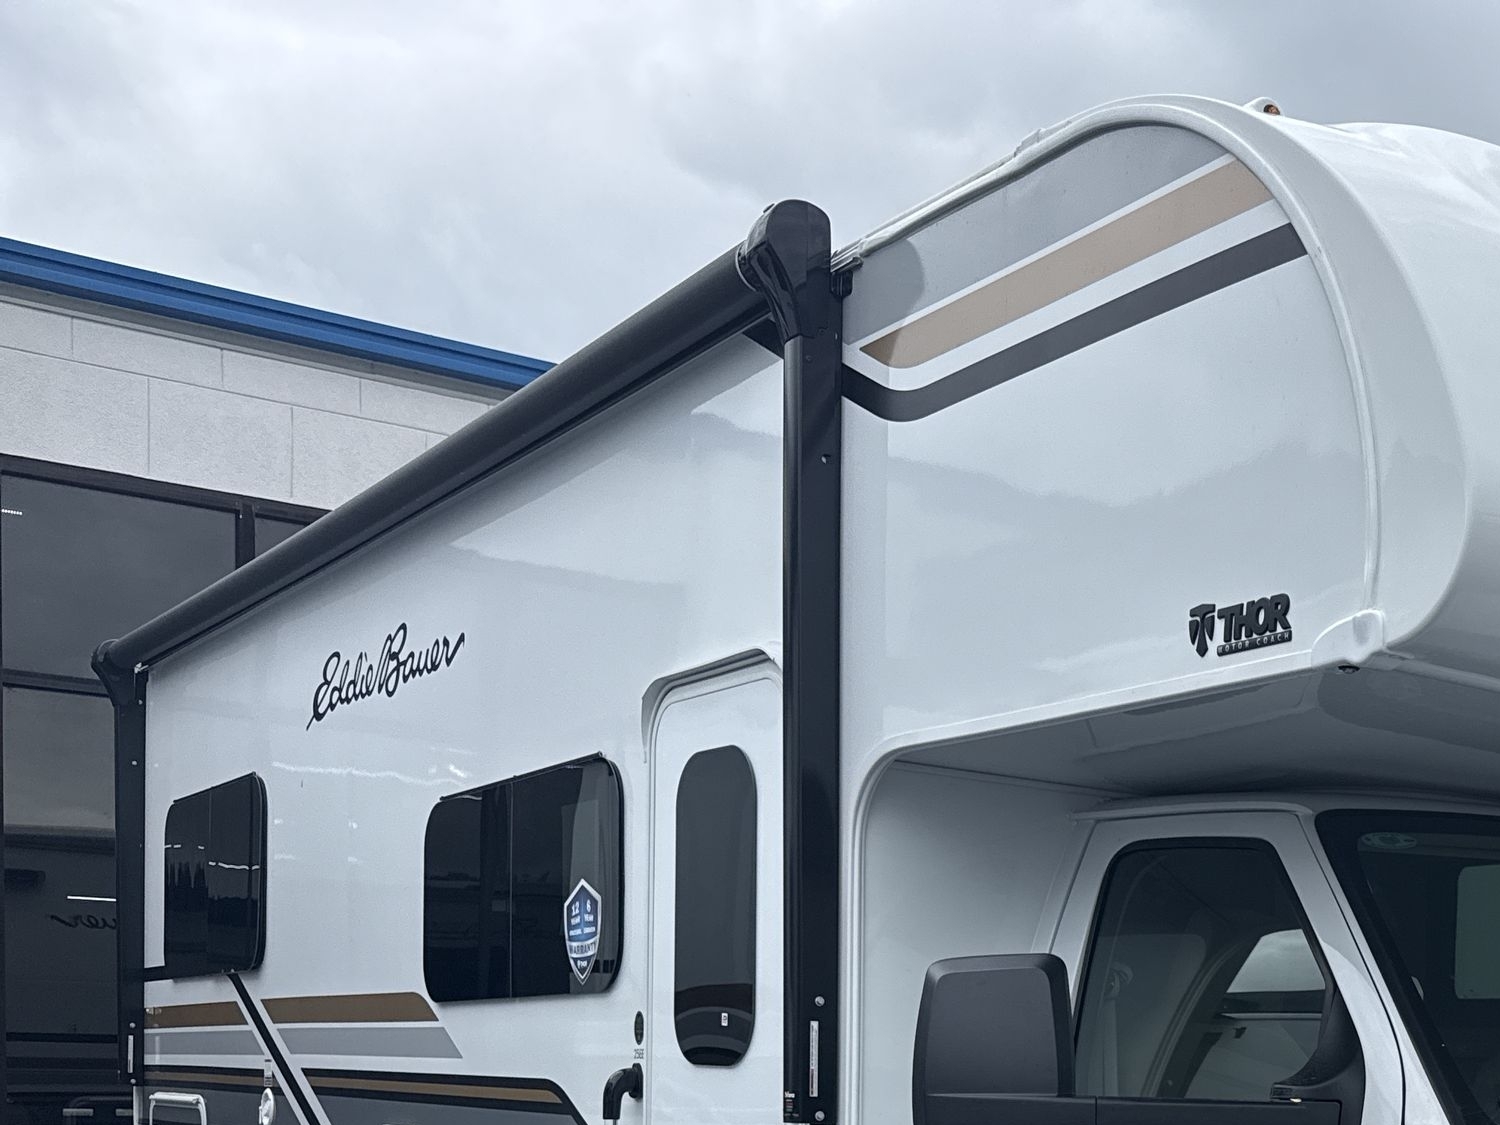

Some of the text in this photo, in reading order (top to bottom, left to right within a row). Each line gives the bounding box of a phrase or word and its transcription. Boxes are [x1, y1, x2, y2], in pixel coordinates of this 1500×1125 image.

[1217, 593, 1292, 643] THOR
[1217, 632, 1290, 654] MOTOR COACH
[306, 622, 466, 731] Eddie Bauer
[571, 899, 592, 916] 12 6
